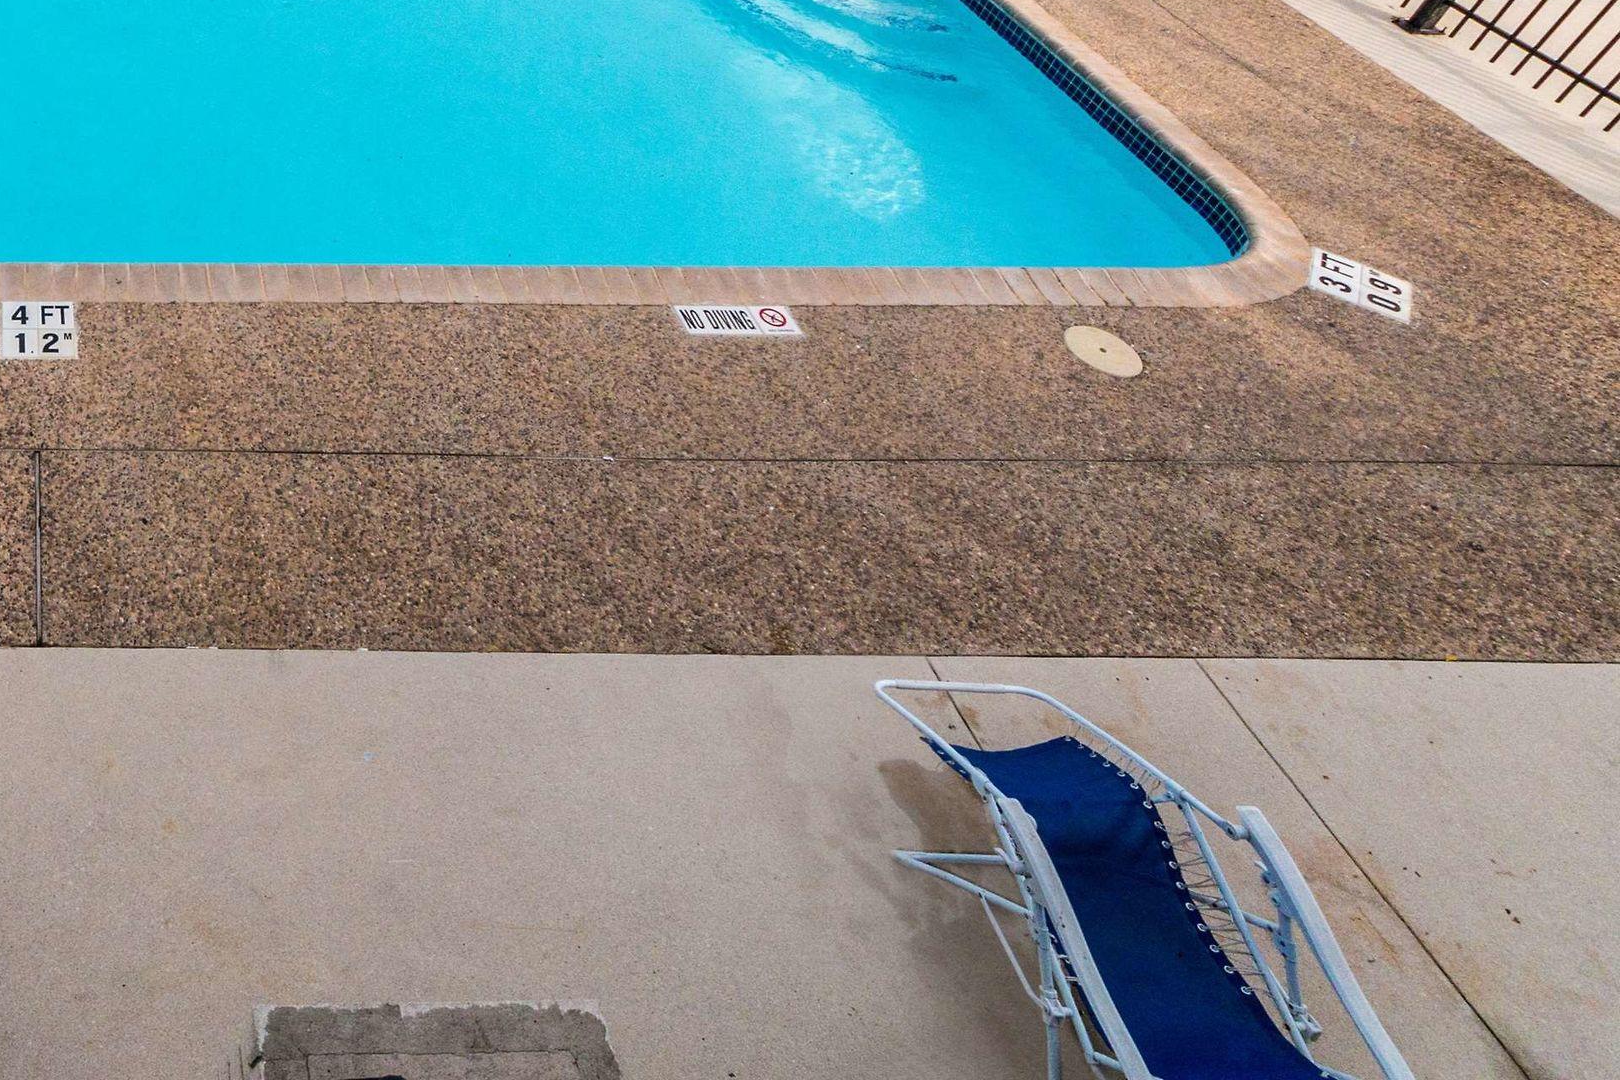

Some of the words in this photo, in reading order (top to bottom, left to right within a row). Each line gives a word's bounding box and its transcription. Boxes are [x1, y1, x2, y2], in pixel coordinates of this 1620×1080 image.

[1321, 252, 1355, 279] FT
[1318, 275, 1352, 294] 3
[11, 305, 29, 325] 4
[40, 305, 70, 325] FT
[679, 308, 705, 330] NO
[703, 309, 757, 331] DIVING
